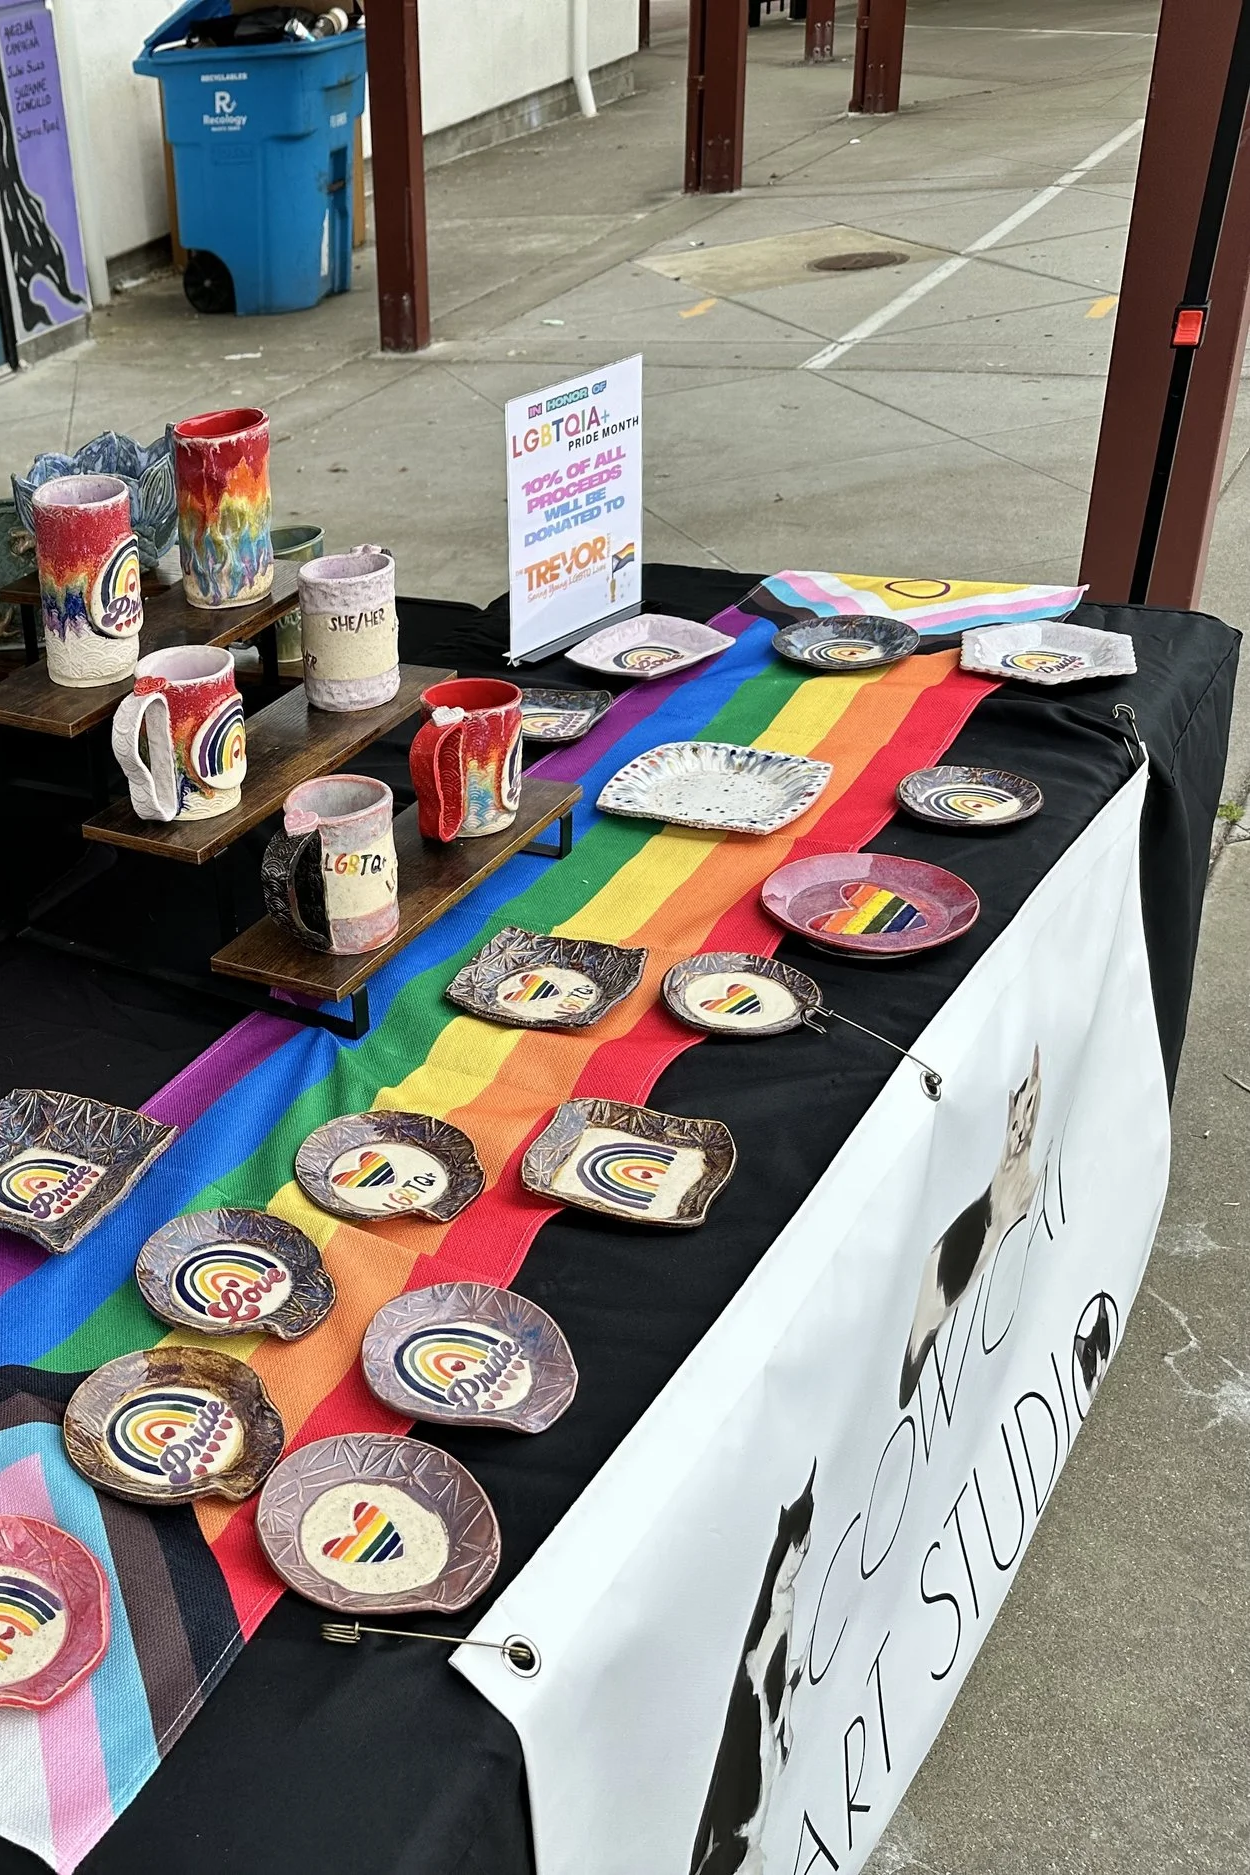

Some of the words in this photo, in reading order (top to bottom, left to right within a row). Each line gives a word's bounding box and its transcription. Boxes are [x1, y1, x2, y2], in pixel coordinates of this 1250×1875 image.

[203, 114, 247, 126] Recology
[528, 403, 542, 419] IN
[546, 387, 588, 412] HONOR
[592, 380, 607, 395] OF
[513, 406, 610, 458] LGBTQIA+
[568, 431, 599, 451] PRIDE
[602, 416, 639, 439] MONTH
[522, 469, 563, 496] 10%
[566, 458, 590, 479] OF
[594, 446, 626, 469] ALL
[527, 464, 622, 514] PROCEEDS
[525, 506, 601, 547] DONATED
[604, 496, 625, 513] TO
[544, 498, 582, 522] WILL
[586, 487, 606, 506] BE
[524, 535, 606, 591] TREVOR
[548, 582, 568, 597] Young
[569, 568, 591, 584] LGBTQ
[592, 563, 606, 574] Lives
[328, 608, 385, 634] SHE/HER
[29, 1165, 92, 1219] Pride
[207, 1268, 286, 1324] Love
[447, 1340, 520, 1414] Pride
[160, 1400, 225, 1484] Pride
[793, 1630, 891, 1875] ART
